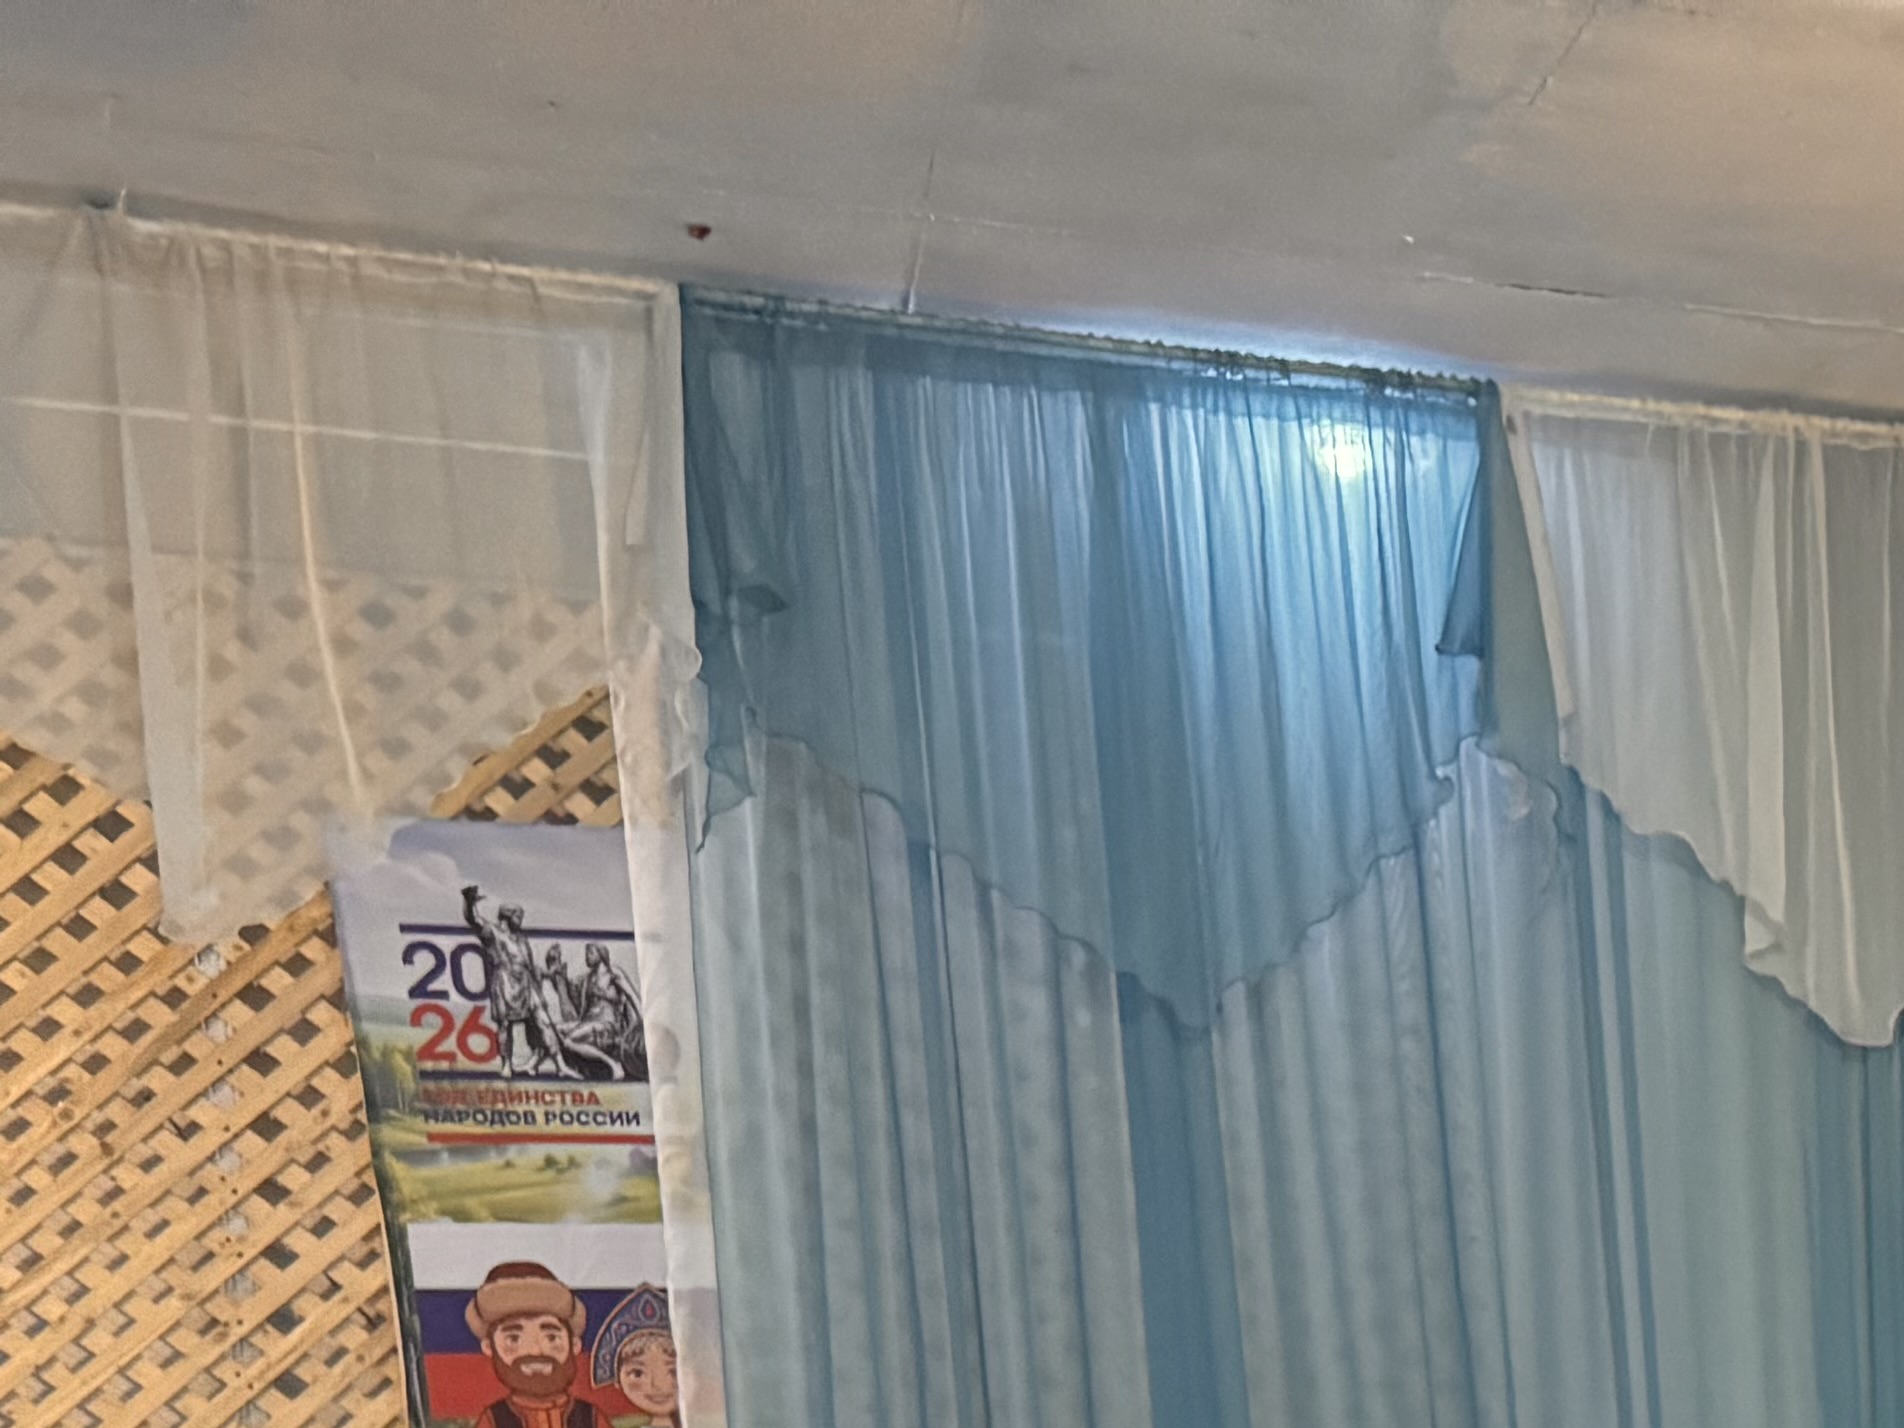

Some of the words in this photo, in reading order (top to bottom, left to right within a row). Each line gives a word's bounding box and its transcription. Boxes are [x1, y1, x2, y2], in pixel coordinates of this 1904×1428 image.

[402, 941, 493, 1001] 20
[410, 1003, 499, 1064] 26
[424, 1109, 537, 1127] НАРОДОВ
[544, 1110, 641, 1127] РОССИИ
[478, 1088, 601, 1108] ЕДИНСТВА
